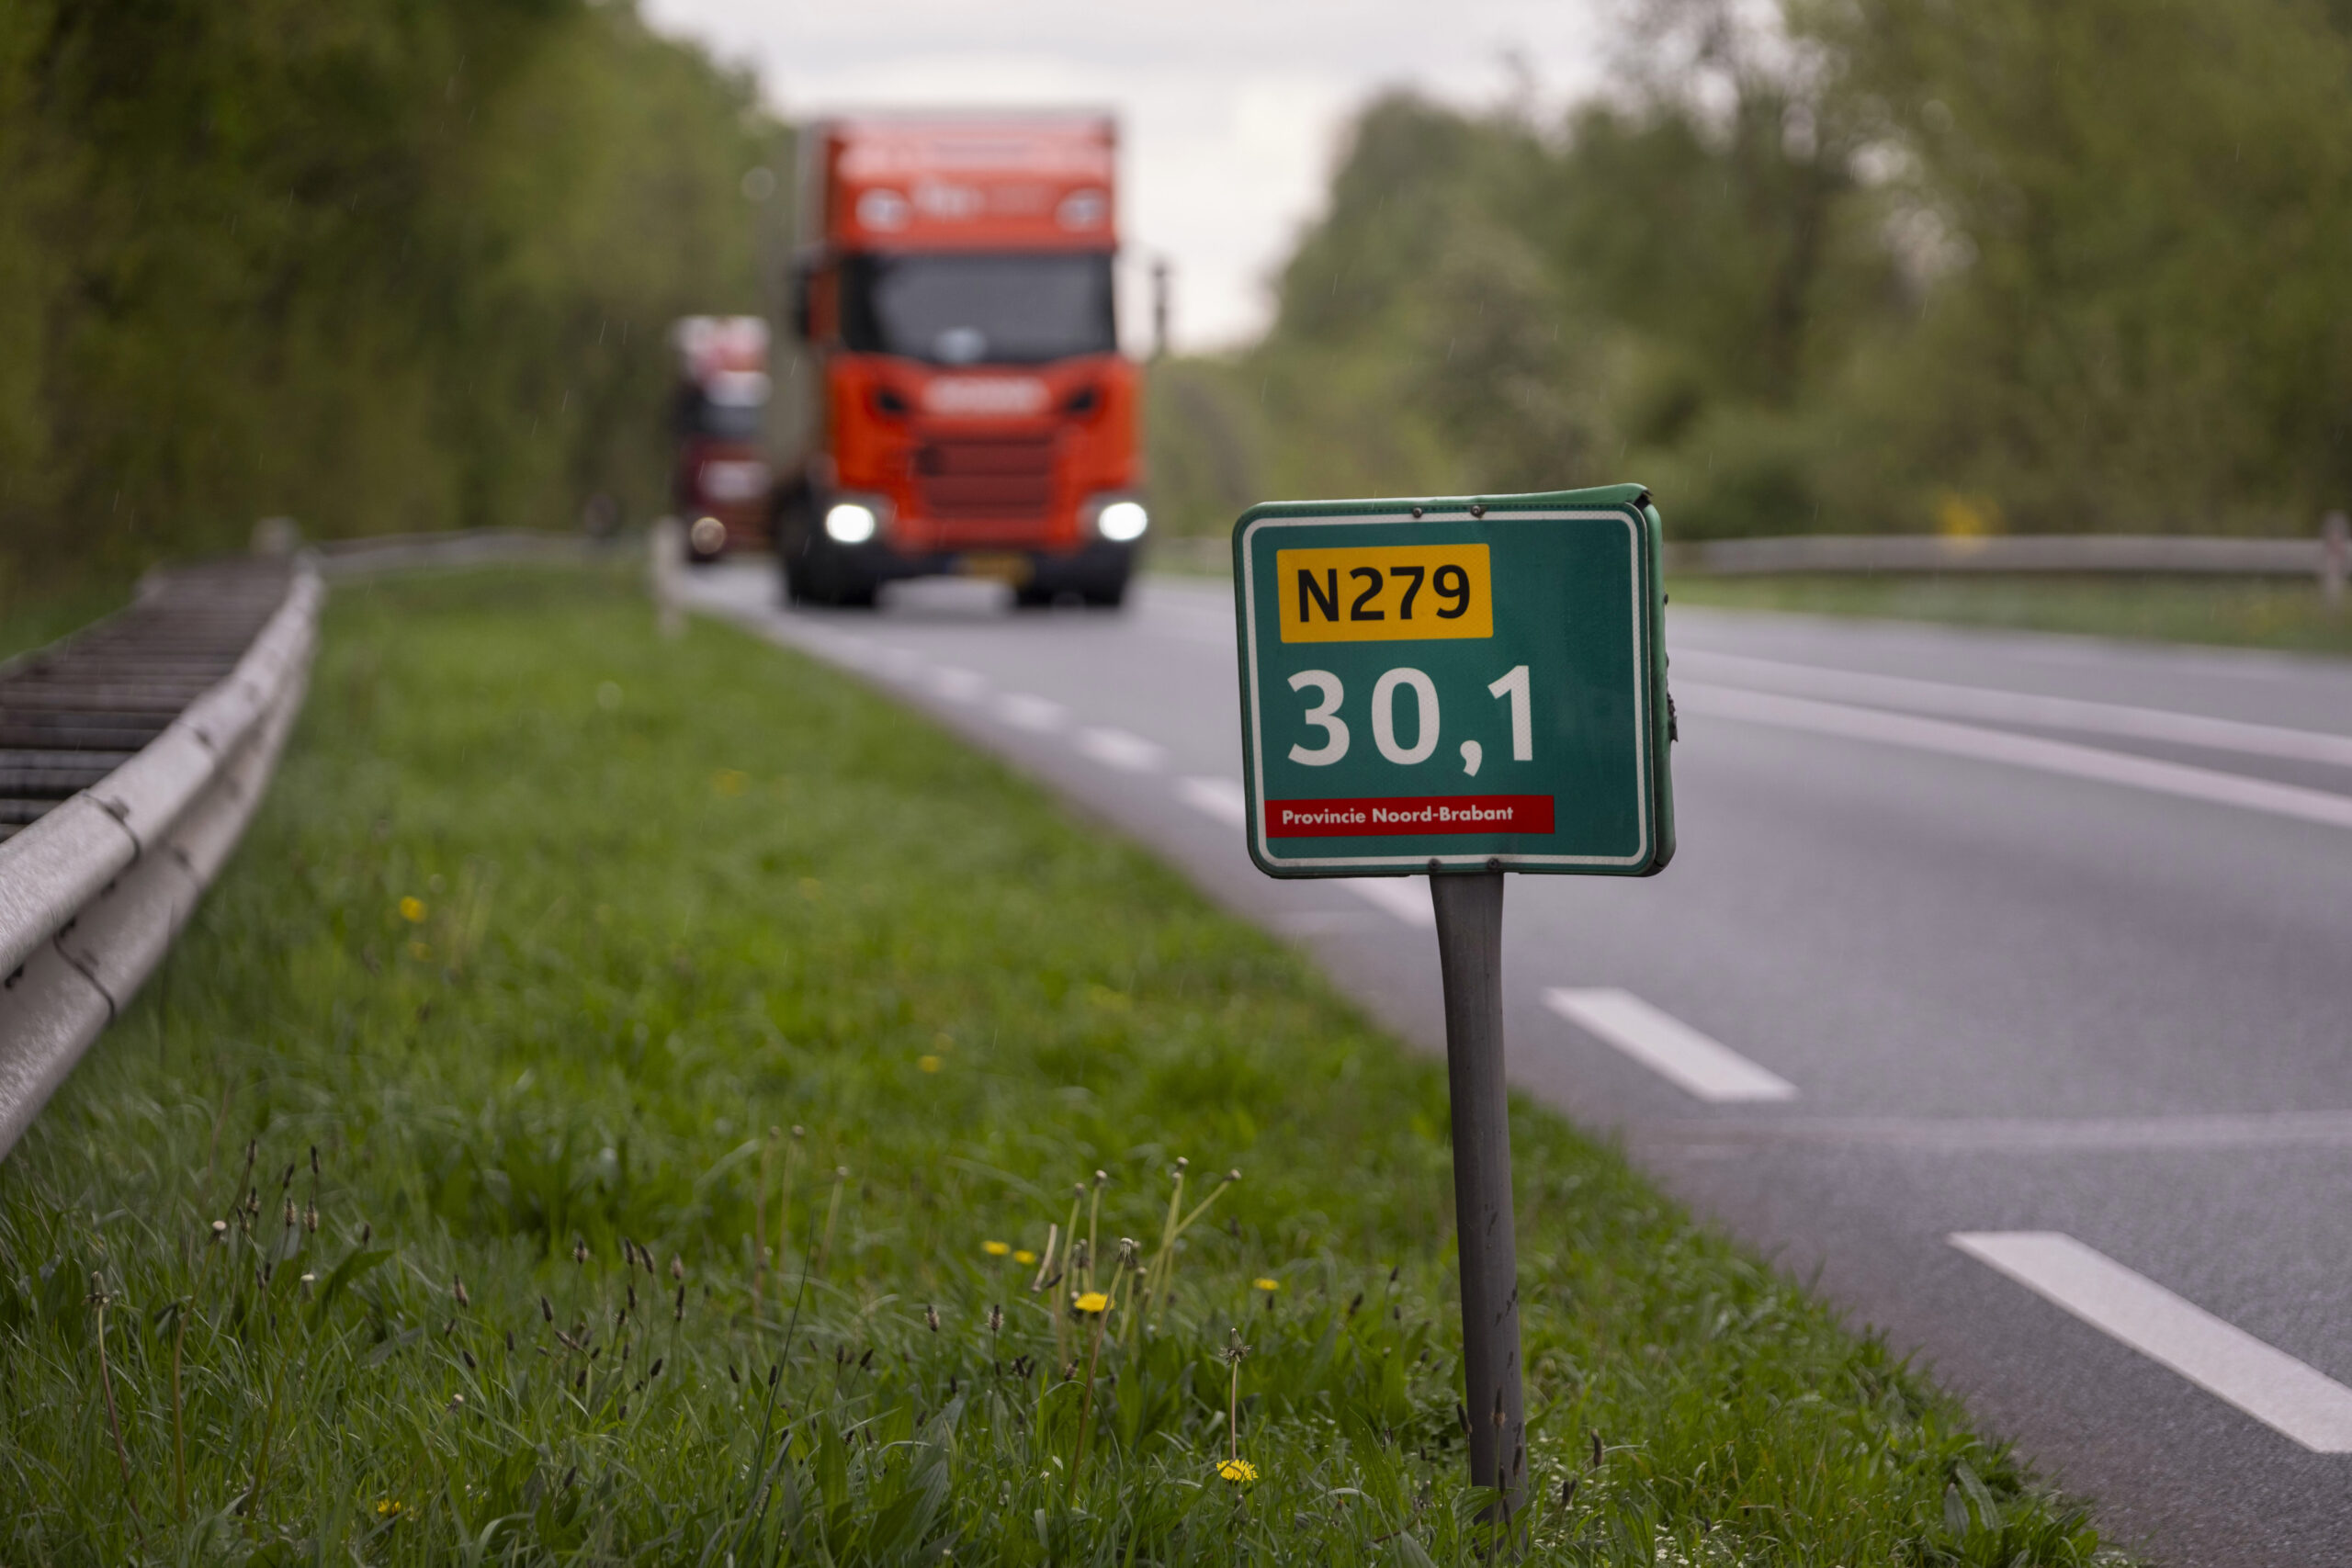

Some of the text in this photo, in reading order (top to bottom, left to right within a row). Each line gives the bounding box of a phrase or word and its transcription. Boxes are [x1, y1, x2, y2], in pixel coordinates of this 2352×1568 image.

[1297, 564, 1471, 623] N279
[1287, 665, 1534, 777] 30,1
[1282, 805, 1514, 826] Provincie Noord-Brabant
